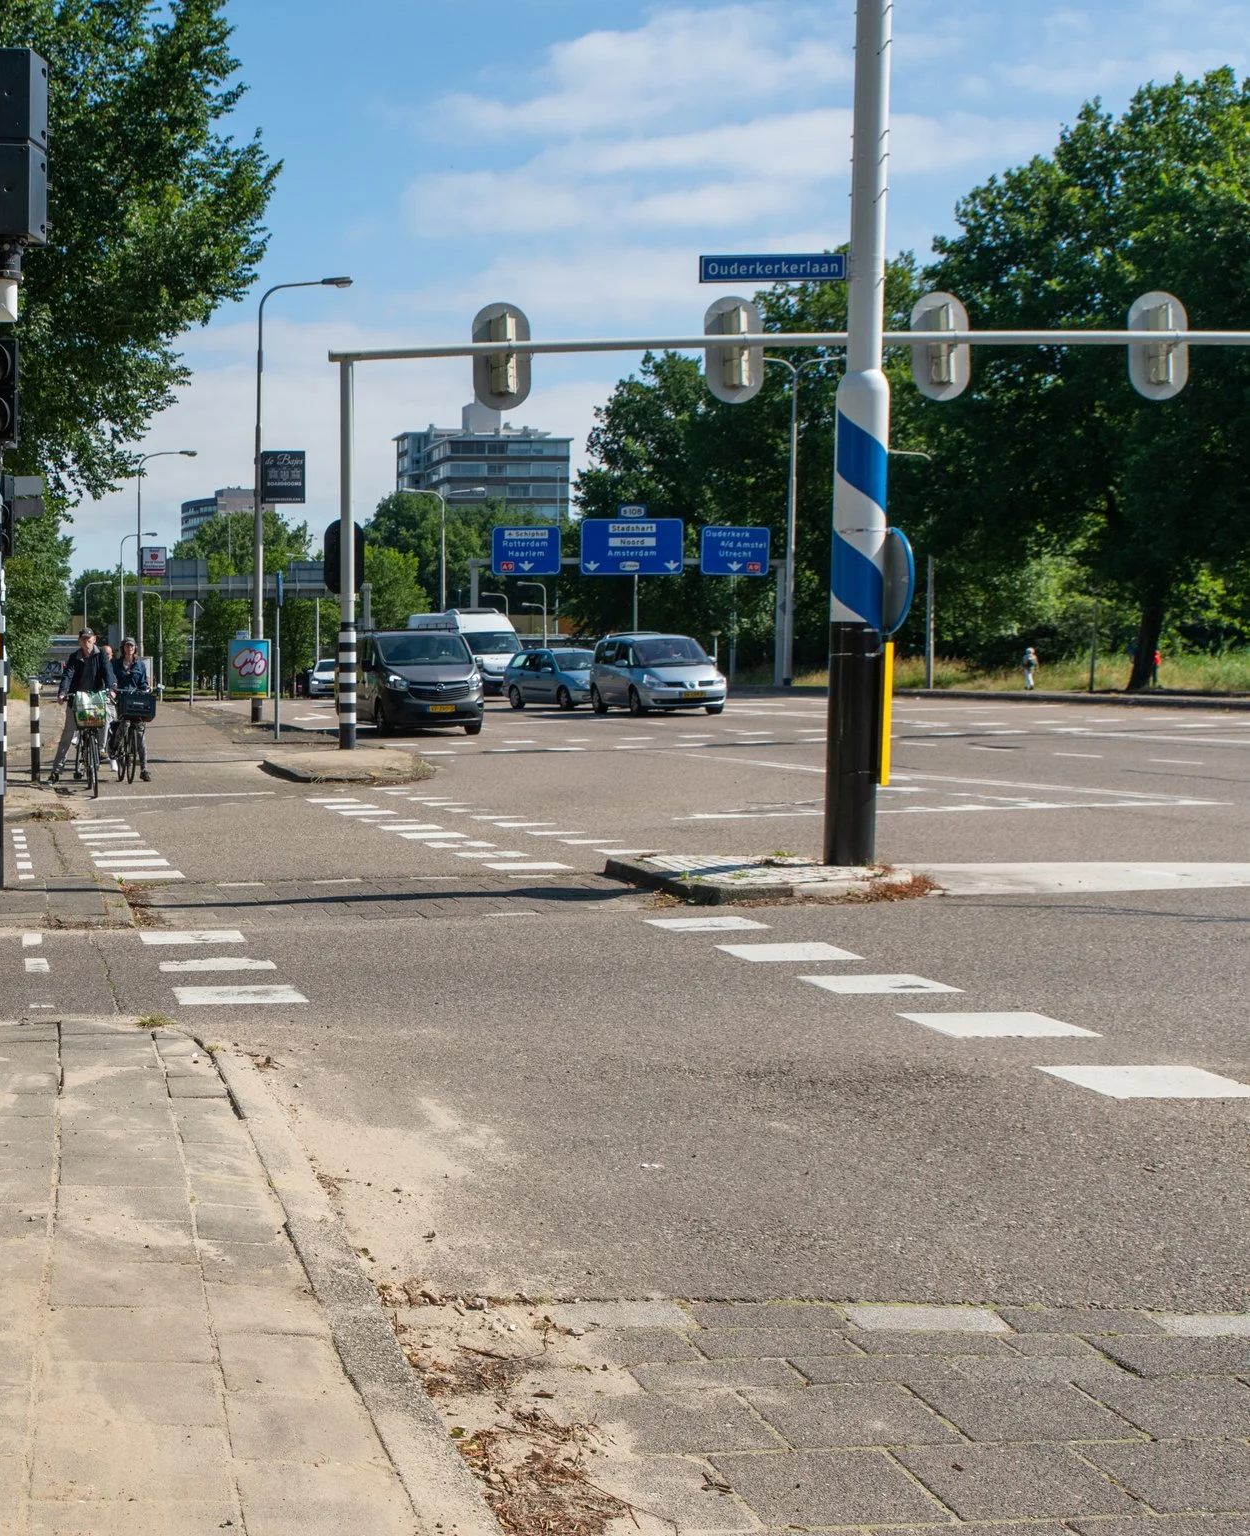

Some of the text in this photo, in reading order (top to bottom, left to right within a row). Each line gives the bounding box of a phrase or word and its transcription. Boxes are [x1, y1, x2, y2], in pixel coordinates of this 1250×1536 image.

[708, 260, 839, 275] Ouderkerkerlaan
[264, 456, 274, 465] de
[515, 531, 547, 539] Schiphol
[705, 530, 750, 538] Ouderkerk
[502, 540, 549, 548] Rotterdam
[620, 538, 645, 546] Noord
[736, 541, 767, 549] Amstel
[607, 549, 657, 557] Amsterdam
[718, 550, 752, 558] Utrecht
